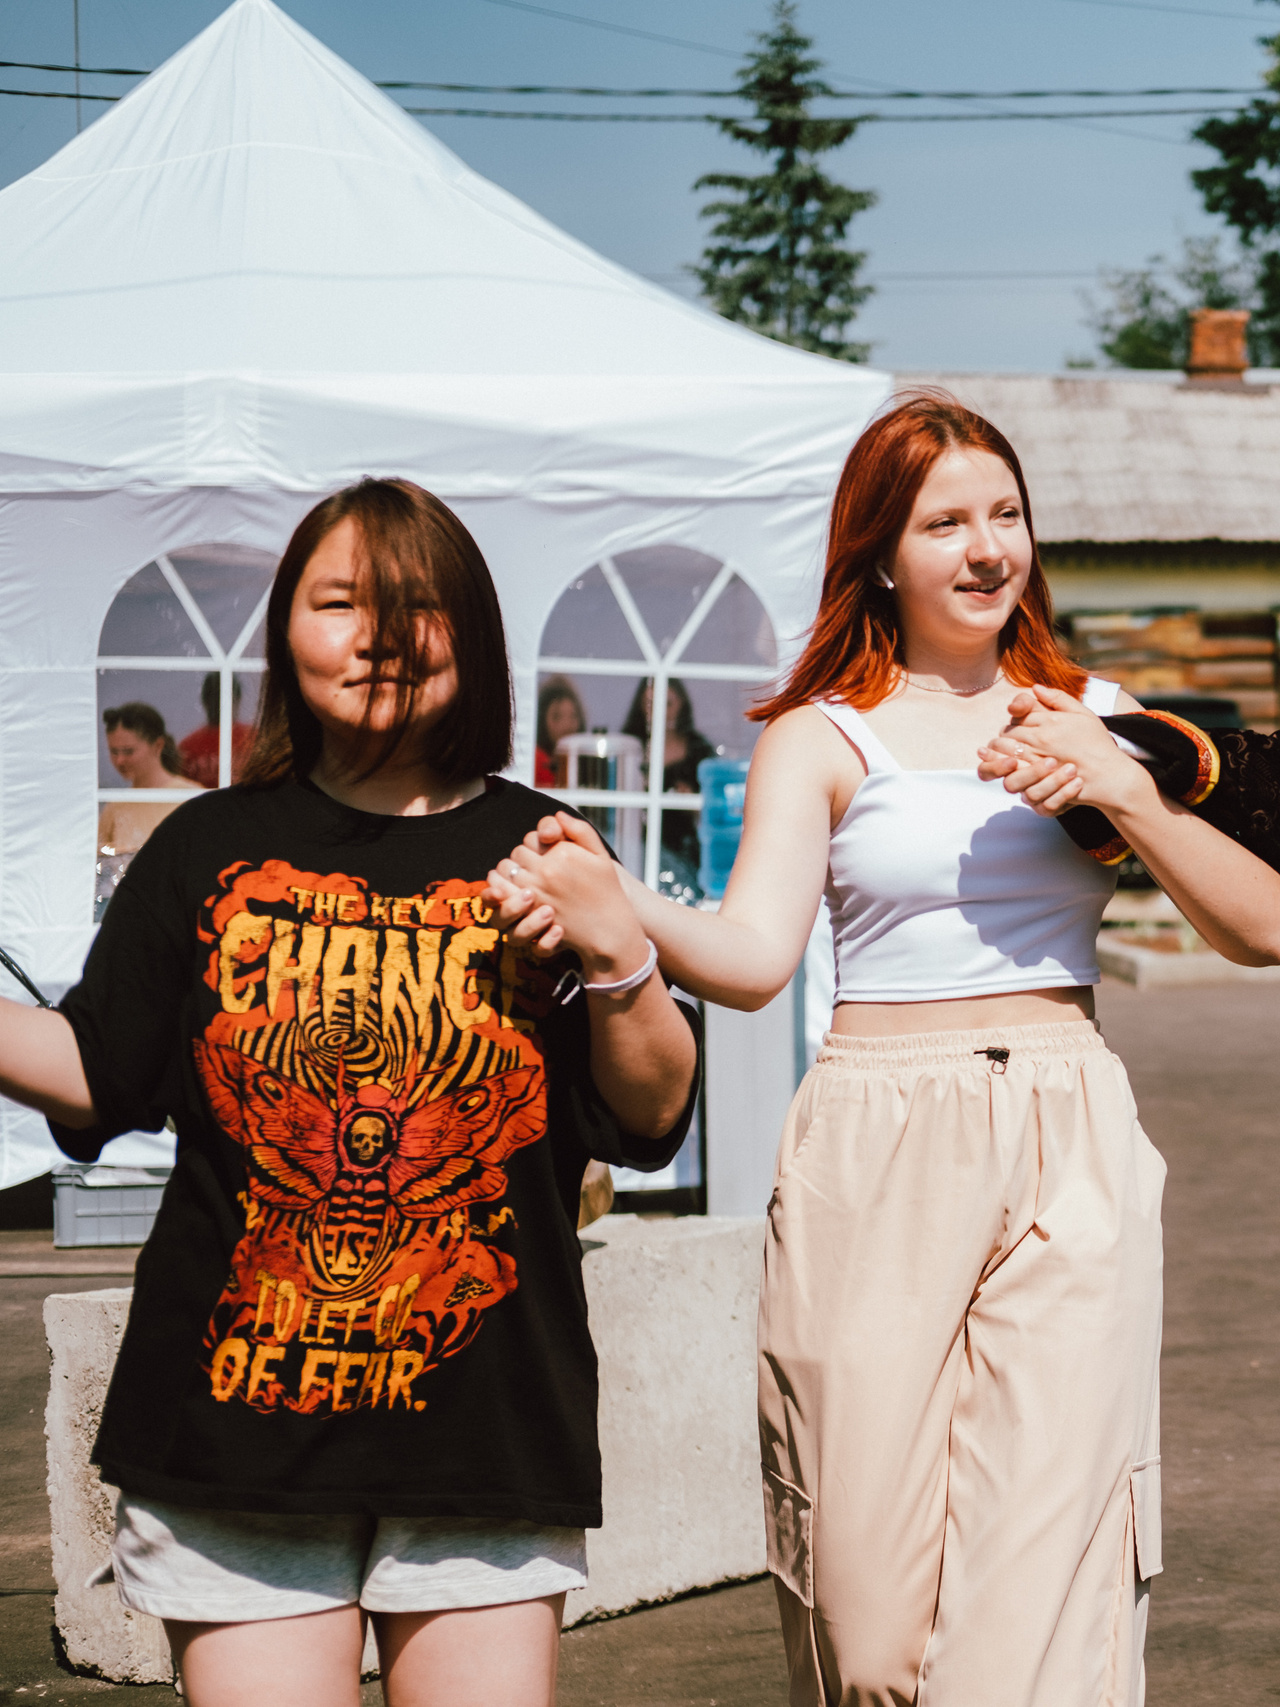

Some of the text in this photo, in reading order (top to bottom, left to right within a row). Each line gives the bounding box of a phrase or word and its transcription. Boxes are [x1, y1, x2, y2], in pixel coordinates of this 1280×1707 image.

[290, 886, 494, 925] THE KEY TO
[253, 1269, 421, 1346] TO LET GO
[210, 1337, 428, 1412] OF FEAR.
